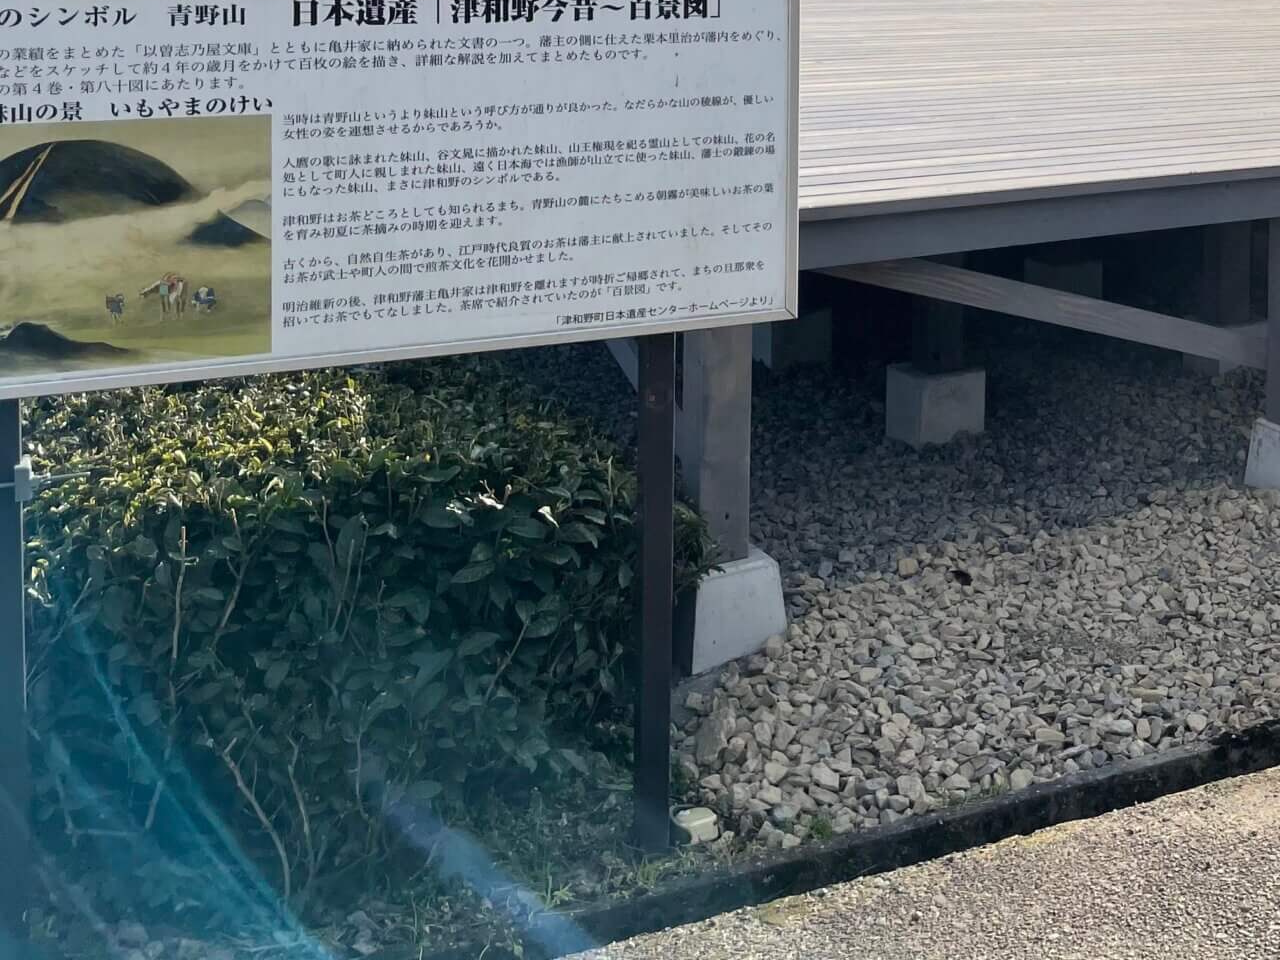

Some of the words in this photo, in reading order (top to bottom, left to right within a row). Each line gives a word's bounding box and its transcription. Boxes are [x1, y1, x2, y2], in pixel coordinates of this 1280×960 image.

[0, 5, 137, 27] のシンボル
[168, 3, 246, 26] 青野山
[110, 96, 273, 117] いもやまのけい
[283, 120, 502, 139] 女性の姿を連想させるからであろうか。
[283, 172, 560, 197] にもなった妹山、まさに津和野のシンボルである。
[283, 216, 503, 240] を育み初夏に茶摘みの時期を迎えます。
